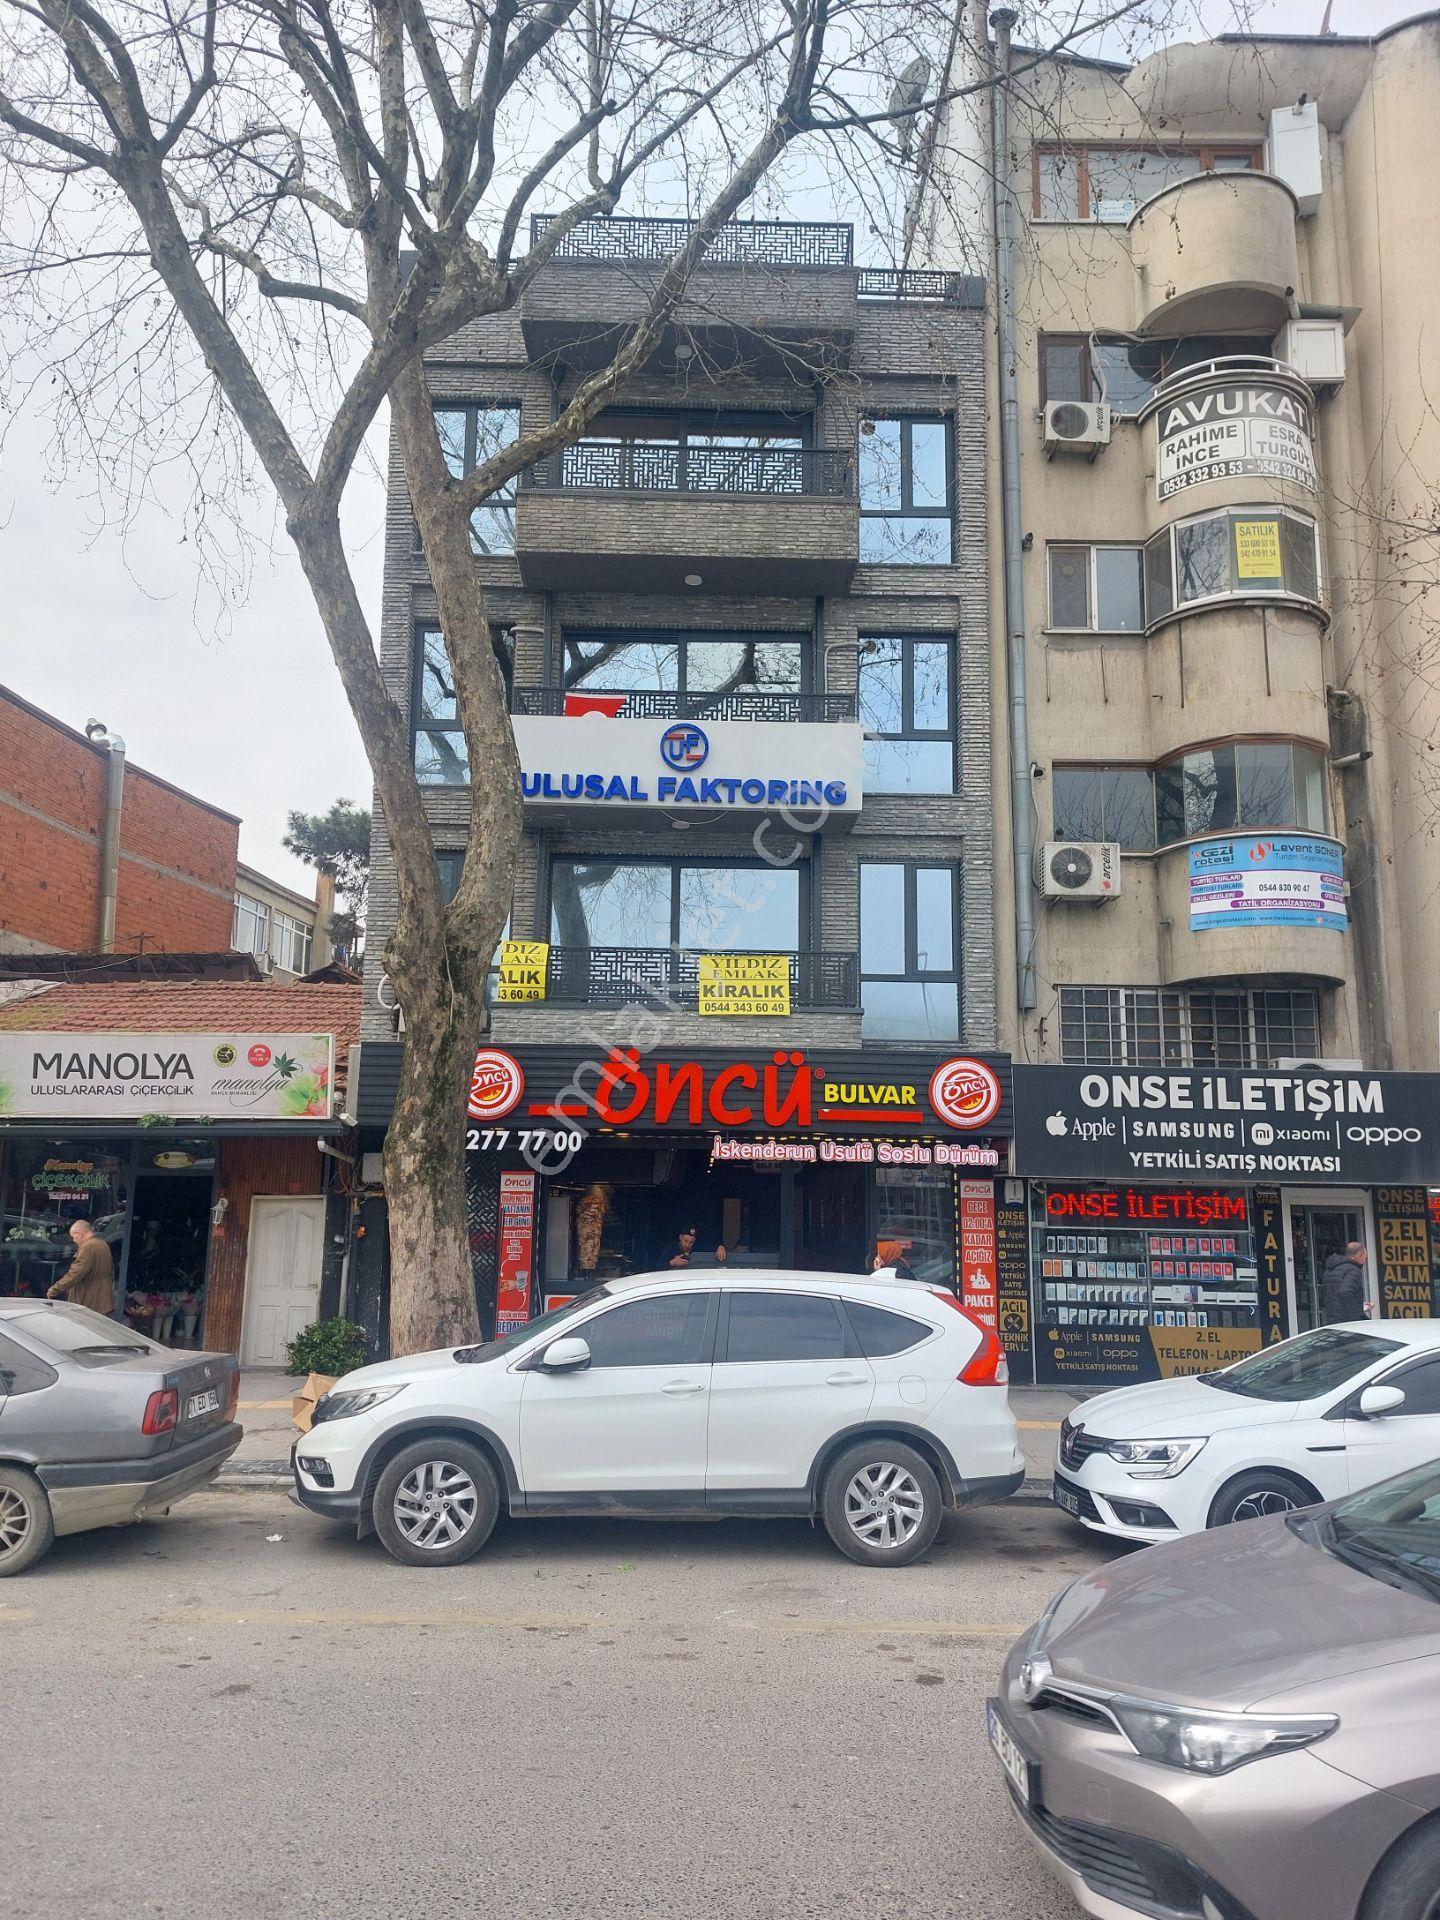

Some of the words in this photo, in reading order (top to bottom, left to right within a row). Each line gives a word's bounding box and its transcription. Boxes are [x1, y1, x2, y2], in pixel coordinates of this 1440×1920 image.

[1163, 391, 1306, 436] AVUKAT
[1166, 424, 1238, 458] RAHİME
[1269, 424, 1303, 448] ESRA
[1176, 445, 1220, 470] İNCE
[1256, 441, 1310, 472] TURGUT
[1163, 474, 1187, 494] 0532
[1189, 469, 1209, 484] 332
[1212, 463, 1226, 476] 93
[1229, 460, 1243, 474] 53
[1282, 464, 1296, 478] 324
[1239, 525, 1275, 536] SATILIK
[520, 772, 648, 801] ULUSAL
[658, 777, 847, 805] FAKTORİNG
[1272, 843, 1313, 852] Levent
[1101, 845, 1113, 879] arçelik
[1215, 874, 1241, 882] TURLARI
[1259, 884, 1277, 892] 0544
[1279, 884, 1292, 892] 830
[1293, 884, 1301, 892] 90
[1238, 899, 1259, 908] TATİL
[1261, 899, 1321, 908] ORGANİZASYONU
[502, 944, 540, 954] DIZ
[501, 955, 536, 963] LAK
[711, 959, 782, 968] YILDIZ
[500, 971, 540, 984] ALIK
[713, 969, 778, 978] EMLAK
[511, 990, 523, 999] 60
[527, 990, 539, 999] 49
[703, 982, 784, 998] KİRALIK
[704, 1003, 730, 1012] 0544
[734, 1003, 752, 1012] 343
[756, 1003, 768, 1012] 60
[772, 1003, 784, 1012] 49
[33, 1053, 195, 1080] MANOLYA
[31, 1085, 124, 1095] ULUSLARARASI
[130, 1085, 194, 1096] ÇİÇEKÇİLİK
[824, 1083, 916, 1104] BULVAR
[1080, 1075, 1194, 1109] ONSE
[1203, 1076, 1384, 1121] İLETİŞİM
[1072, 1116, 1115, 1141] Apple
[1132, 1121, 1235, 1139] SAMSUNG
[1276, 1128, 1330, 1141] xiaomi
[1347, 1126, 1421, 1146] oppo
[466, 1131, 510, 1150] 277
[518, 1131, 545, 1151] 77
[553, 1132, 582, 1152] 00
[714, 1135, 816, 1161] İskenderun
[820, 1141, 873, 1161] Usulü
[878, 1142, 931, 1164] Soslu
[935, 1145, 998, 1166] Dürüm
[1130, 1149, 1201, 1168] YETKİLİ
[1205, 1153, 1256, 1174] SATIŞ
[1260, 1155, 1341, 1172] NOKTASI
[1378, 1189, 1424, 1202] ONSE
[968, 1201, 987, 1213] GECE
[1047, 1192, 1118, 1216] ONSE
[1127, 1189, 1246, 1225] İLETİŞİM
[1378, 1203, 1425, 1213] İLETİŞİM
[998, 1210, 1025, 1220] ONSE
[1007, 1229, 1025, 1240] Apple
[1383, 1222, 1423, 1241] 2.EL
[964, 1234, 992, 1245] KADAR
[966, 1248, 992, 1264] AÇIĞIZ
[1385, 1245, 1426, 1262] SIFIR
[1263, 1210, 1283, 1343] FATURA
[1384, 1266, 1430, 1283] ALIM
[1004, 1281, 1022, 1289] SATIŞ
[1384, 1284, 1431, 1300] SATIM
[964, 1294, 994, 1307] PAKET
[1001, 1301, 1026, 1312] ACİL
[497, 1320, 526, 1332] BEDAV
[999, 1332, 1028, 1342] TEKNİK
[1061, 1331, 1083, 1343] Apple
[1092, 1334, 1141, 1342] SAMSUNG
[1208, 1332, 1221, 1342] EL
[1103, 1349, 1138, 1358] oppo
[1158, 1348, 1208, 1359] TELEFON
[1056, 1362, 1084, 1370] YETKİLİ
[1085, 1363, 1105, 1371] SATIŞ
[1107, 1363, 1138, 1371] NOKTASI
[1173, 1366, 1203, 1376] ALIM
